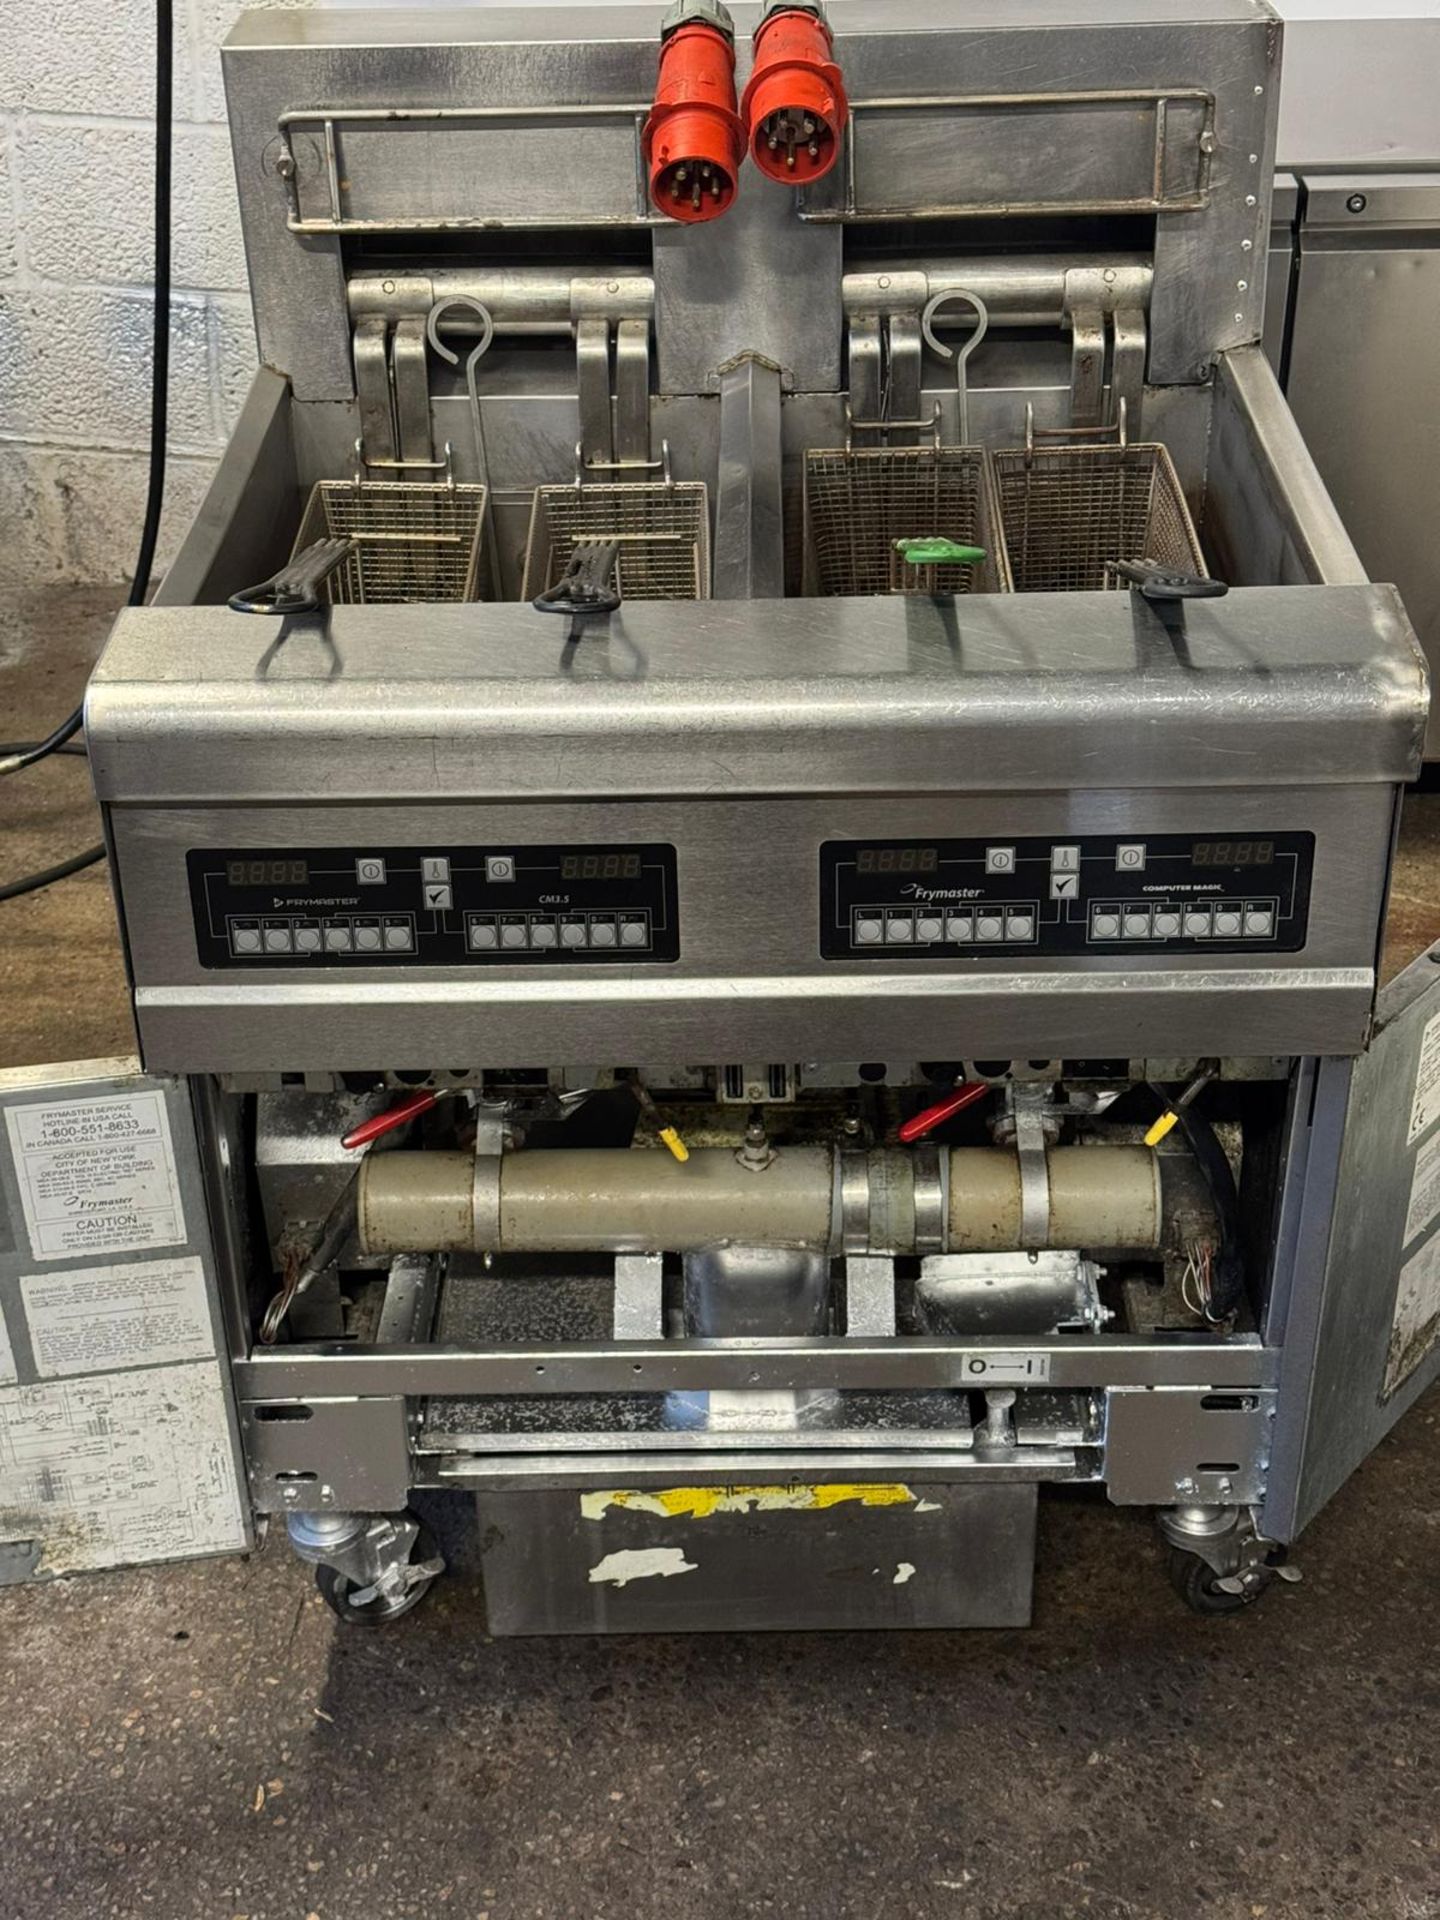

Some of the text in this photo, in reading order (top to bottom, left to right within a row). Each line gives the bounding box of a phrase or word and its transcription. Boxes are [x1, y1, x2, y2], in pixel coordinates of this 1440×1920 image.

[1142, 883, 1222, 892] COMPUTER MAGIC
[538, 894, 570, 904] CM3.5
[915, 887, 981, 900] Frymaster
[286, 897, 359, 907] FRYMASTER
[41, 1104, 132, 1119] FRYMASTER SERVICE
[43, 1118, 78, 1127] HOTLINE
[37, 1138, 71, 1147] CANADA
[74, 1135, 95, 1143] CALL
[52, 1151, 97, 1160] ACCEPTED
[41, 1166, 98, 1177] DEPARTMENT
[80, 1195, 133, 1209] Frymaster
[76, 1215, 137, 1230] CAUTION
